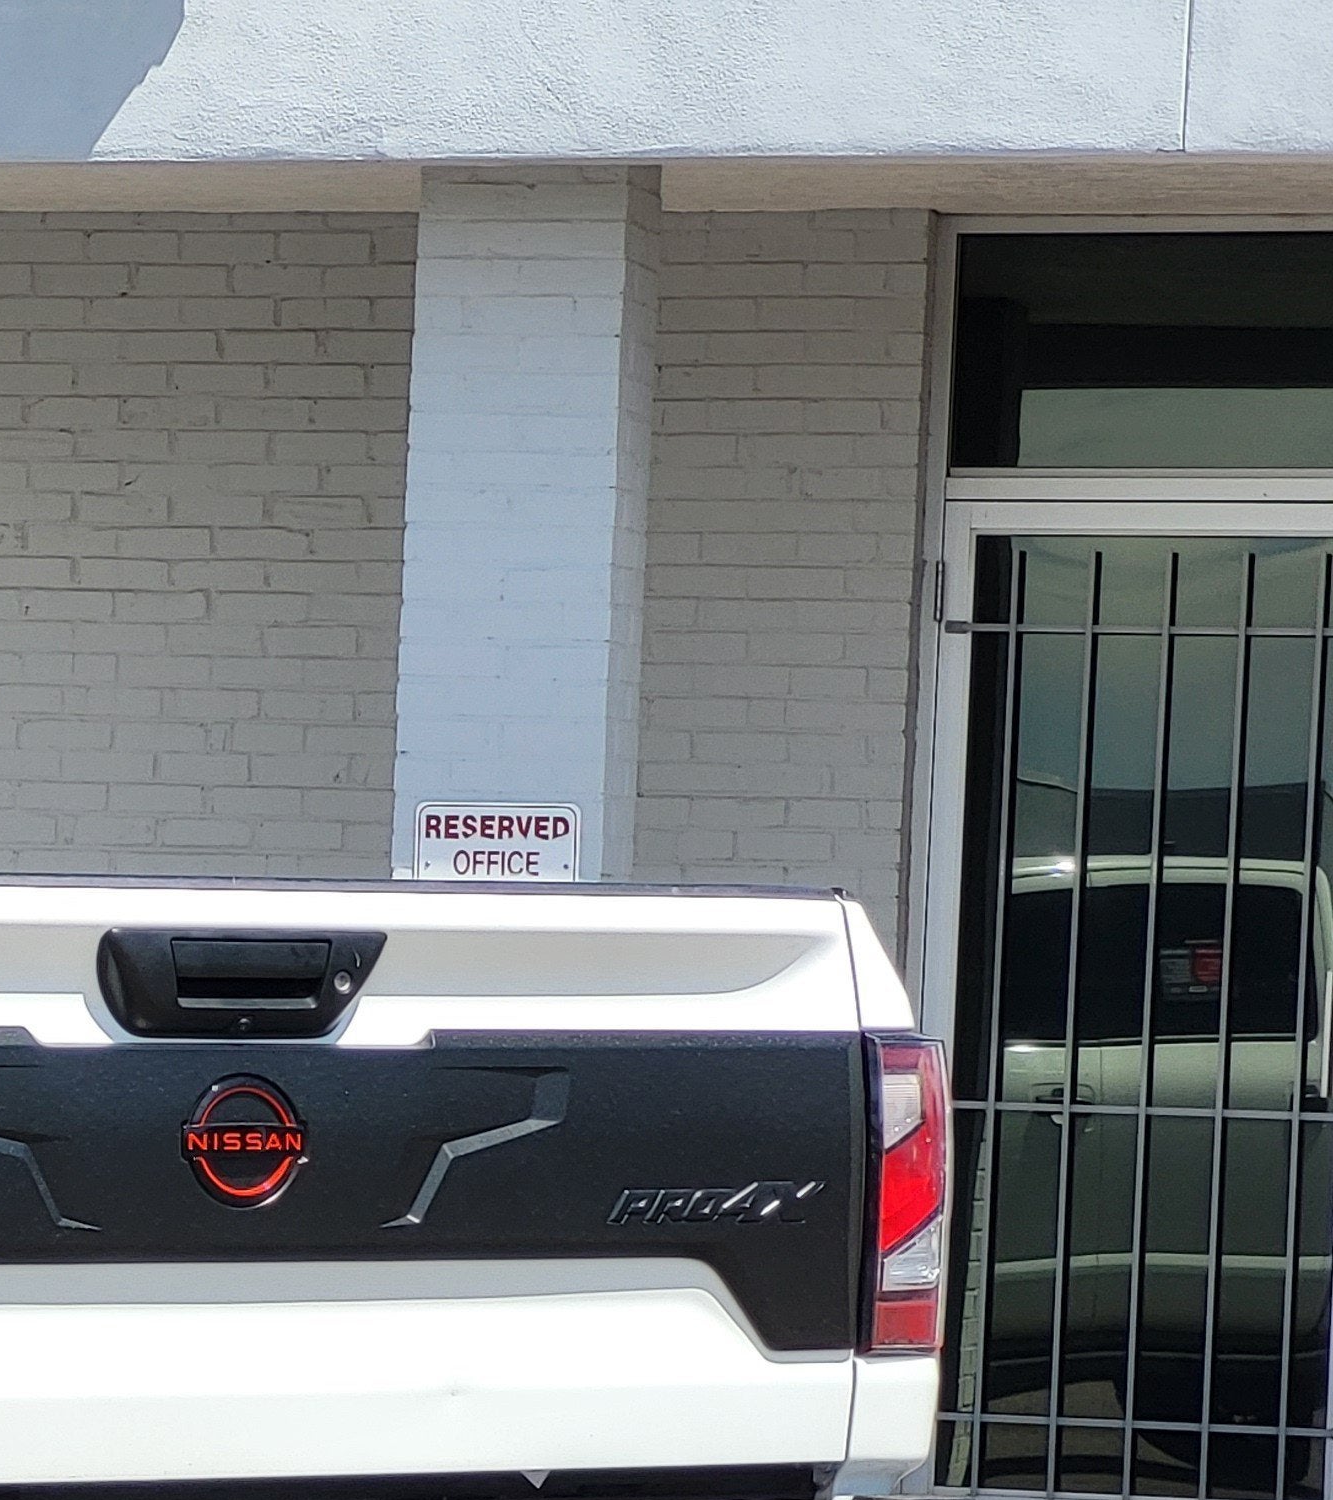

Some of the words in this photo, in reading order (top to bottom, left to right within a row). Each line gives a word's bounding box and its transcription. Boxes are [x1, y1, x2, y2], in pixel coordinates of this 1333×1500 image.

[425, 814, 570, 840] RESERVED
[453, 850, 540, 876] OFFICE
[187, 1132, 302, 1151] NISSAN
